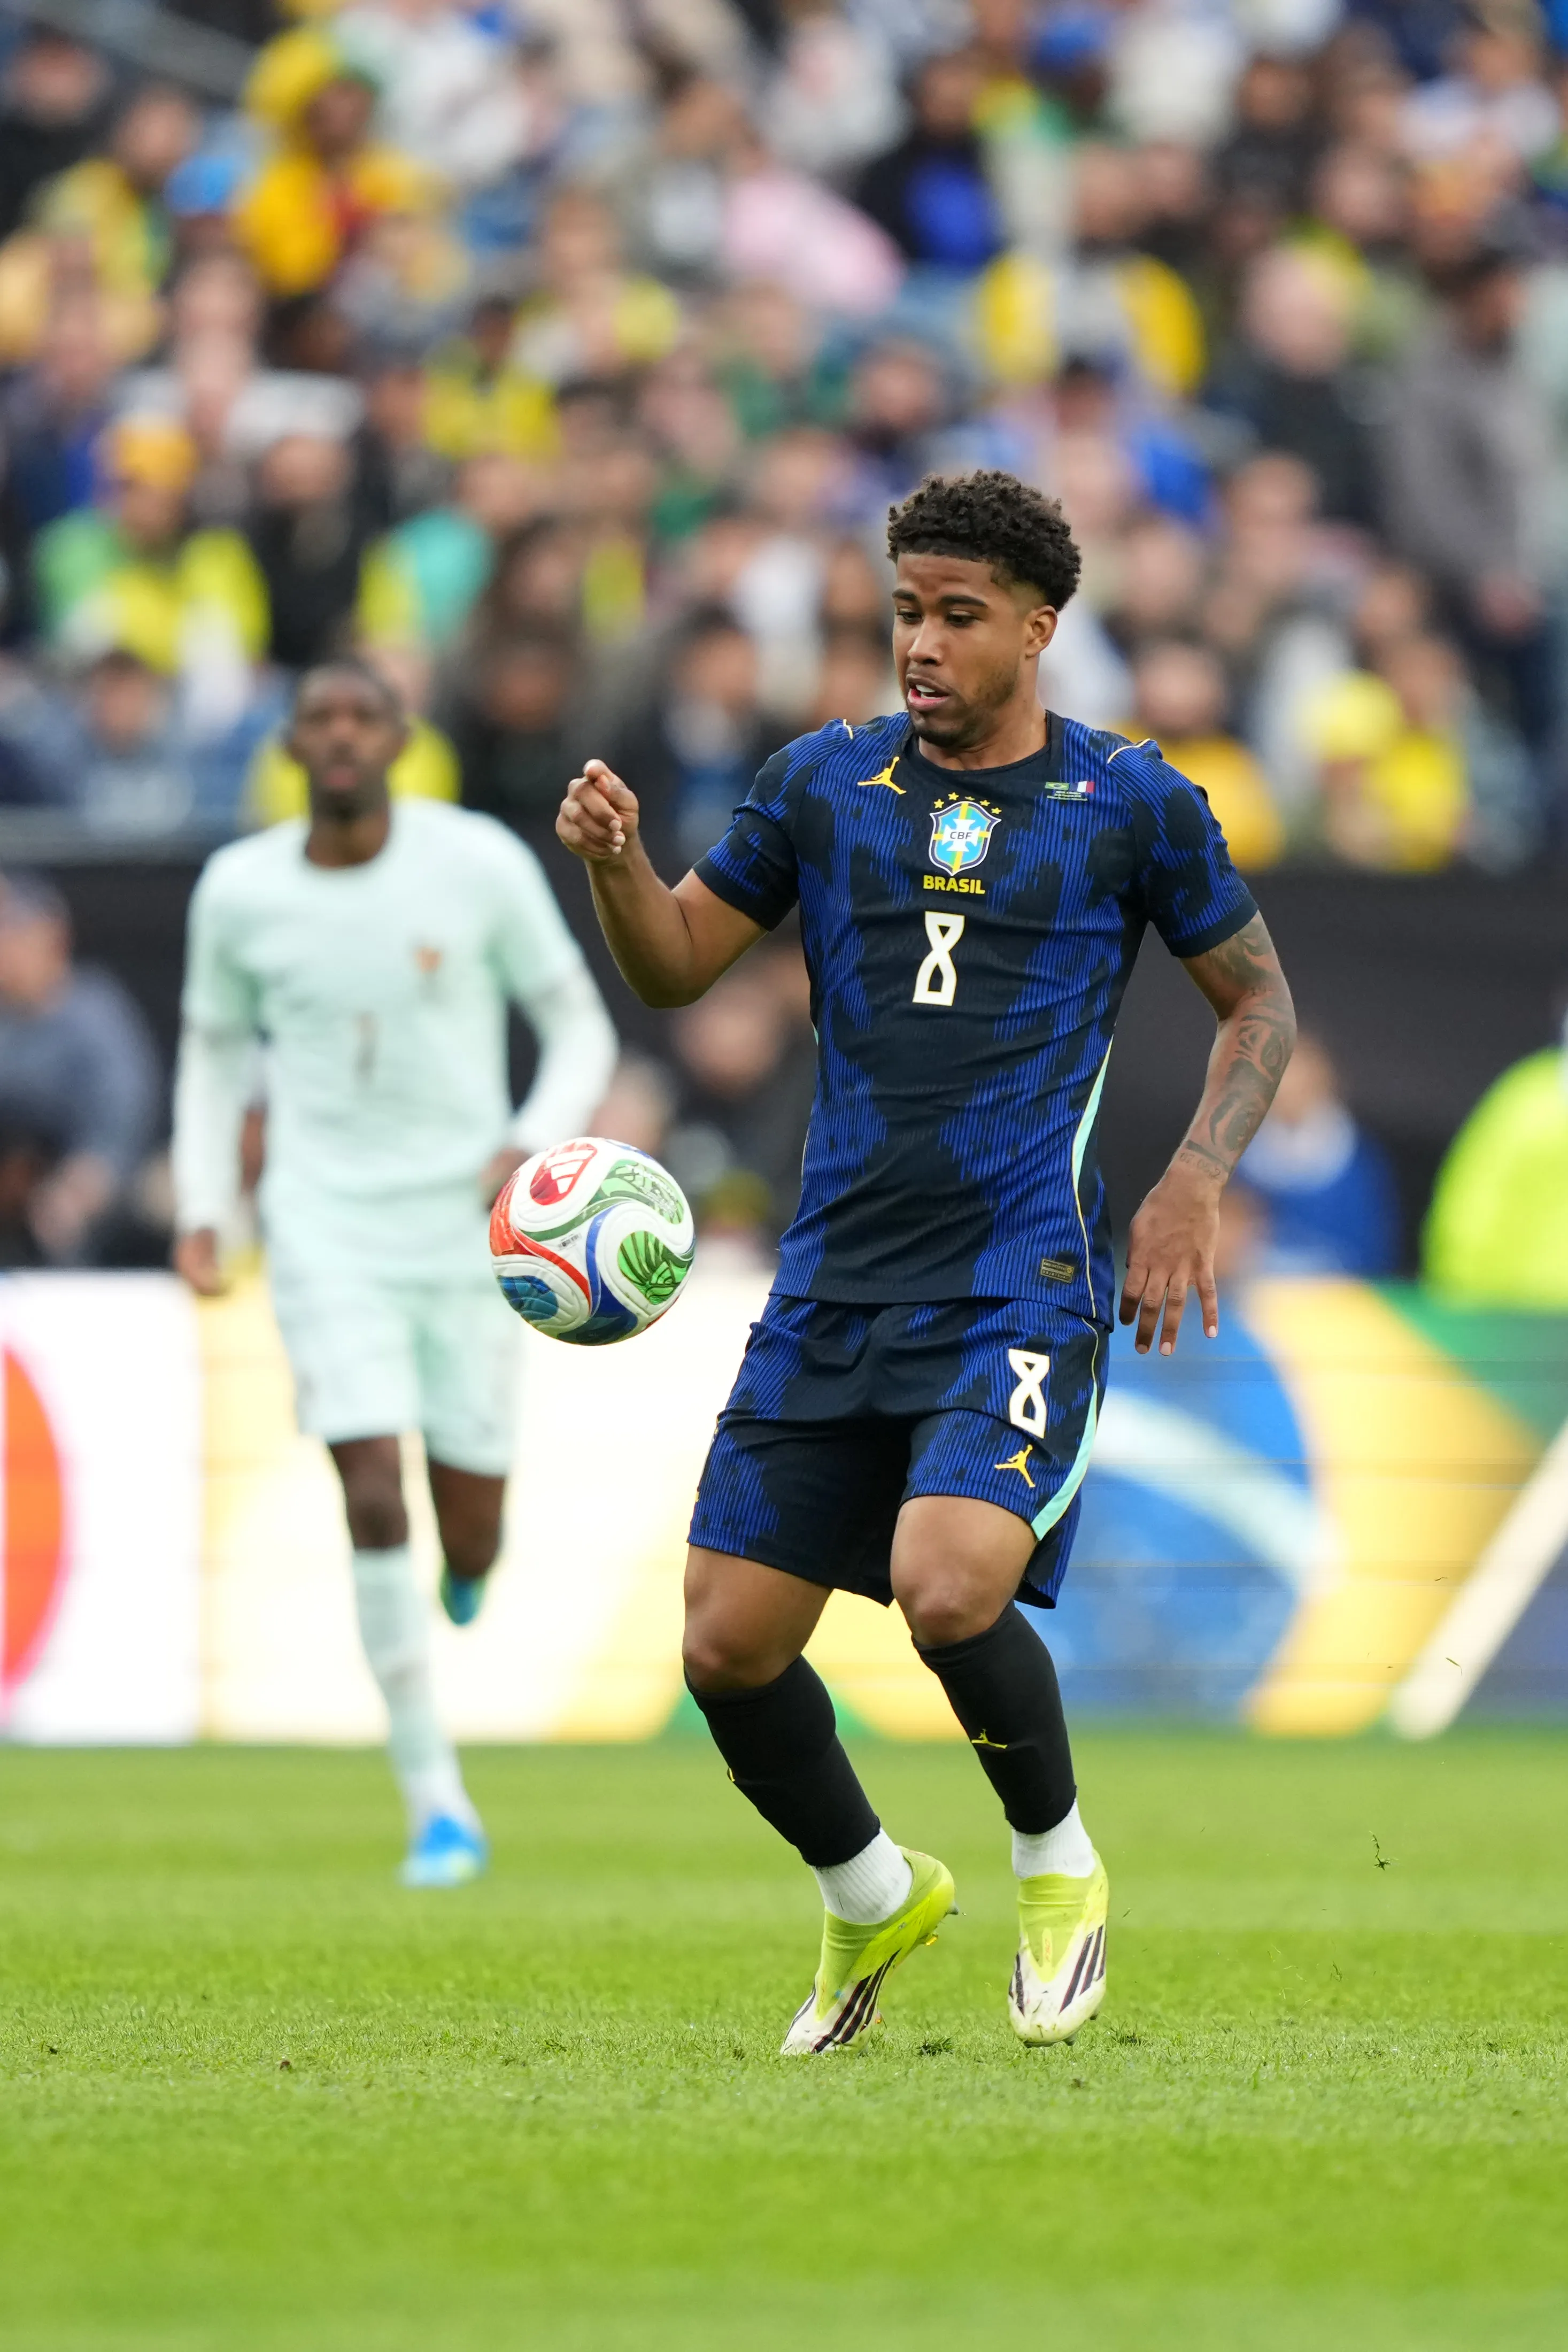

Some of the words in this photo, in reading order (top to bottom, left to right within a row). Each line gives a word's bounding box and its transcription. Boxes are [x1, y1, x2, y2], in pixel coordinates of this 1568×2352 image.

[950, 831, 973, 840] CBF
[923, 875, 986, 894] BRASIL
[912, 911, 965, 1006] 8
[1008, 1348, 1050, 1439] 8
